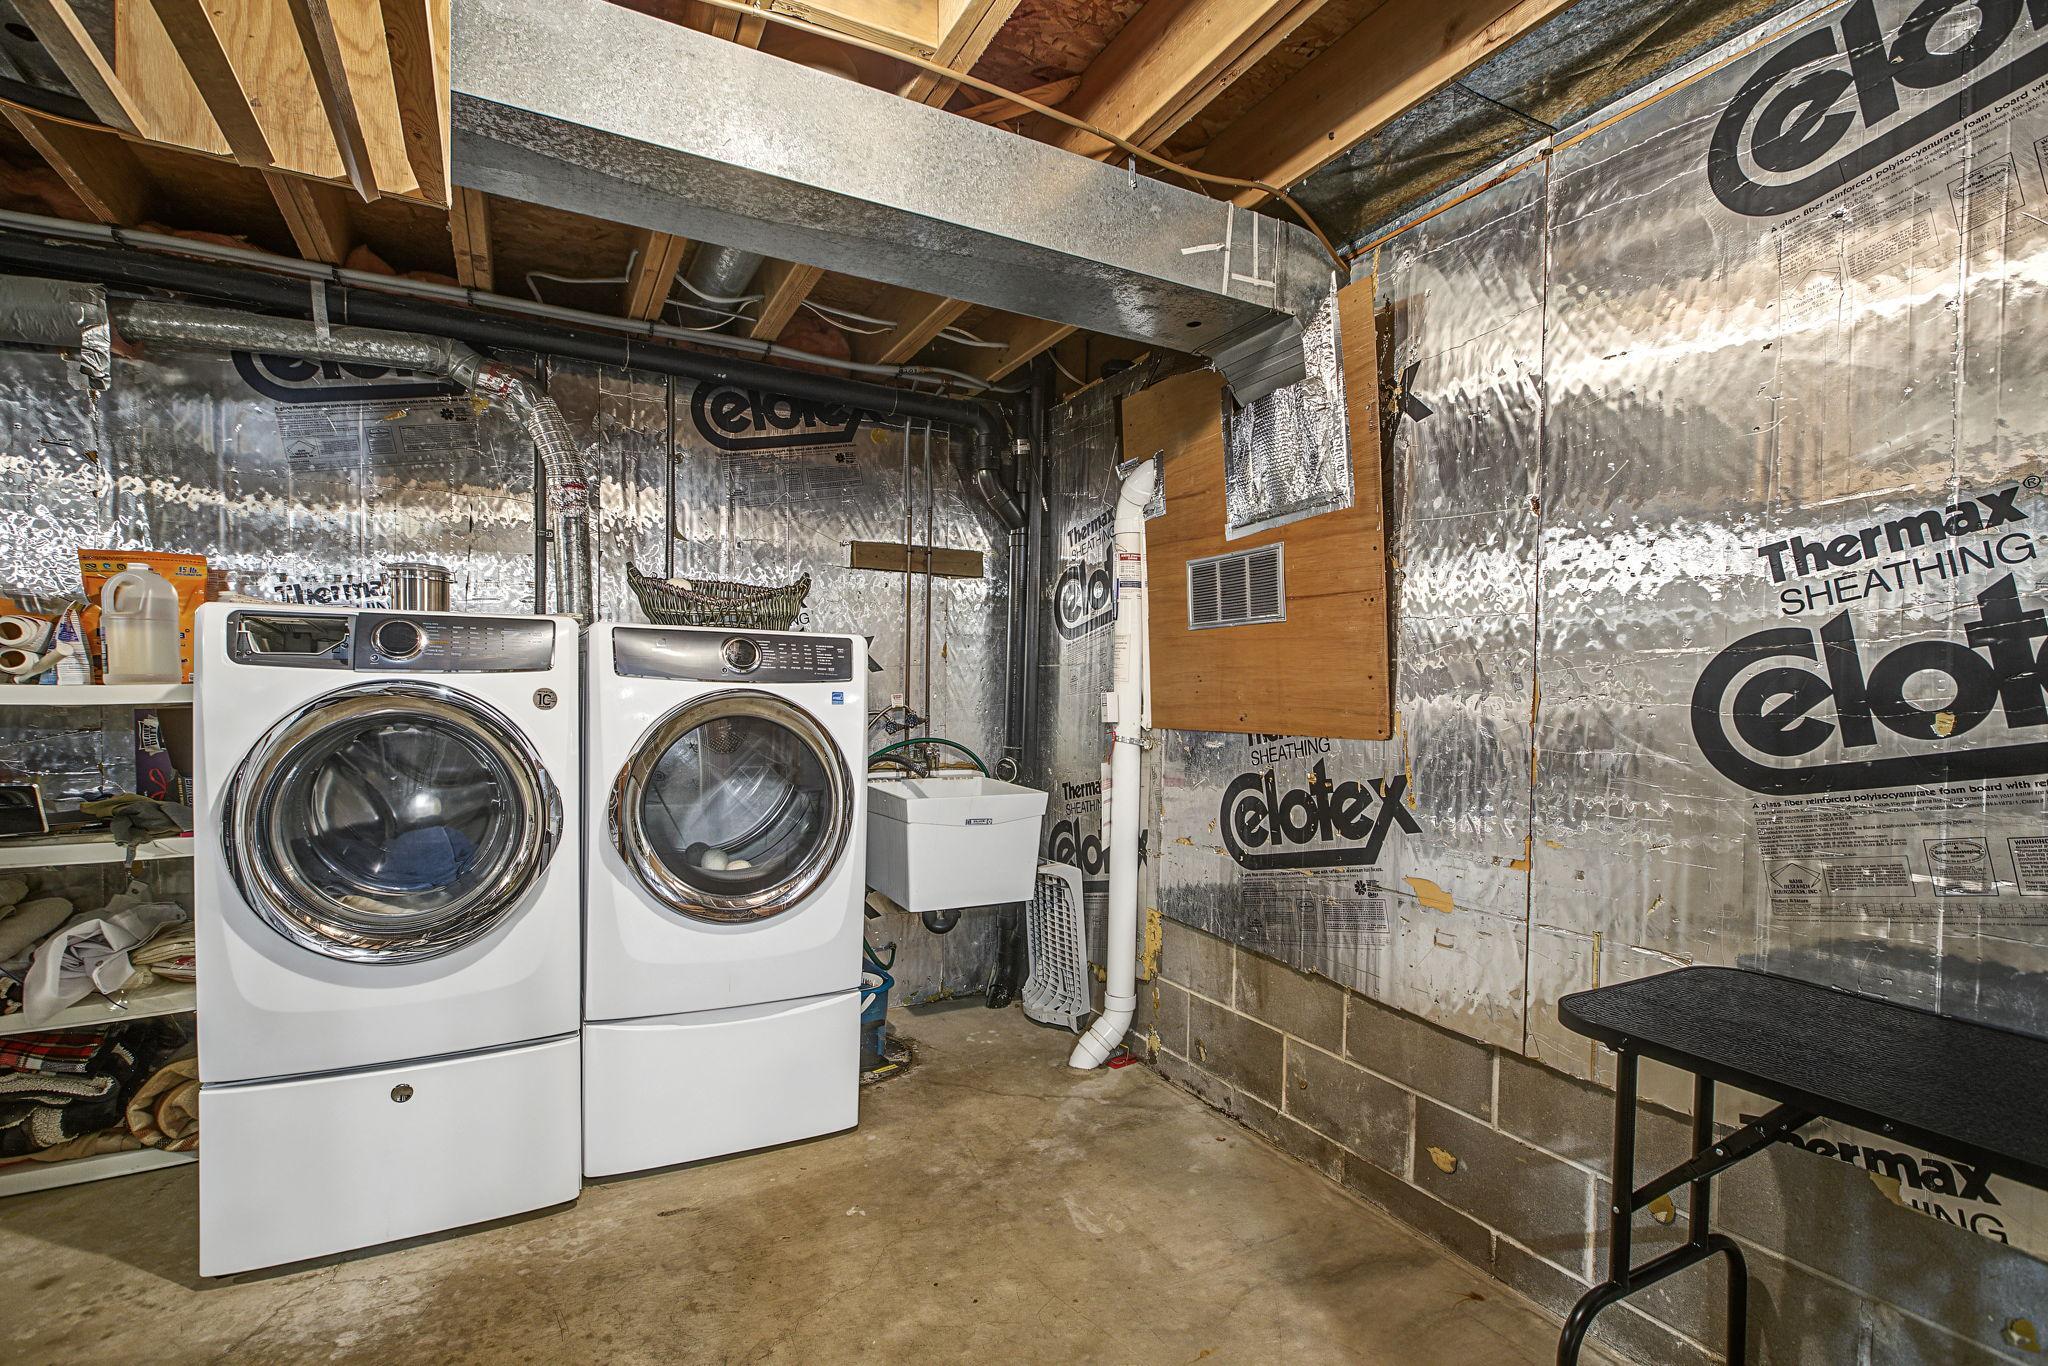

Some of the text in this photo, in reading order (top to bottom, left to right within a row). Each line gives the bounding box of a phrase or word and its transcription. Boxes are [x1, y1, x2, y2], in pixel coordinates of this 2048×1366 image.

[1802, 202, 1825, 217] fiber
[1825, 173, 1873, 204] reinforced
[1875, 129, 1961, 179] polyisocyanurate
[1963, 111, 1992, 131] foam
[1994, 91, 2029, 114] board
[1780, 533, 2037, 616] SHEATHING
[1251, 736, 1331, 766] SHEATHING
[1062, 778, 1102, 801] Therma
[1219, 757, 1424, 871] Celotex
[1761, 801, 1782, 810] glass
[1784, 799, 1803, 807] fiber
[1805, 794, 1852, 806] reinforced
[1853, 788, 1937, 803] polyisocyanurate
[1939, 786, 1966, 795] foam
[1968, 782, 2003, 793] board
[2006, 780, 2031, 790] with
